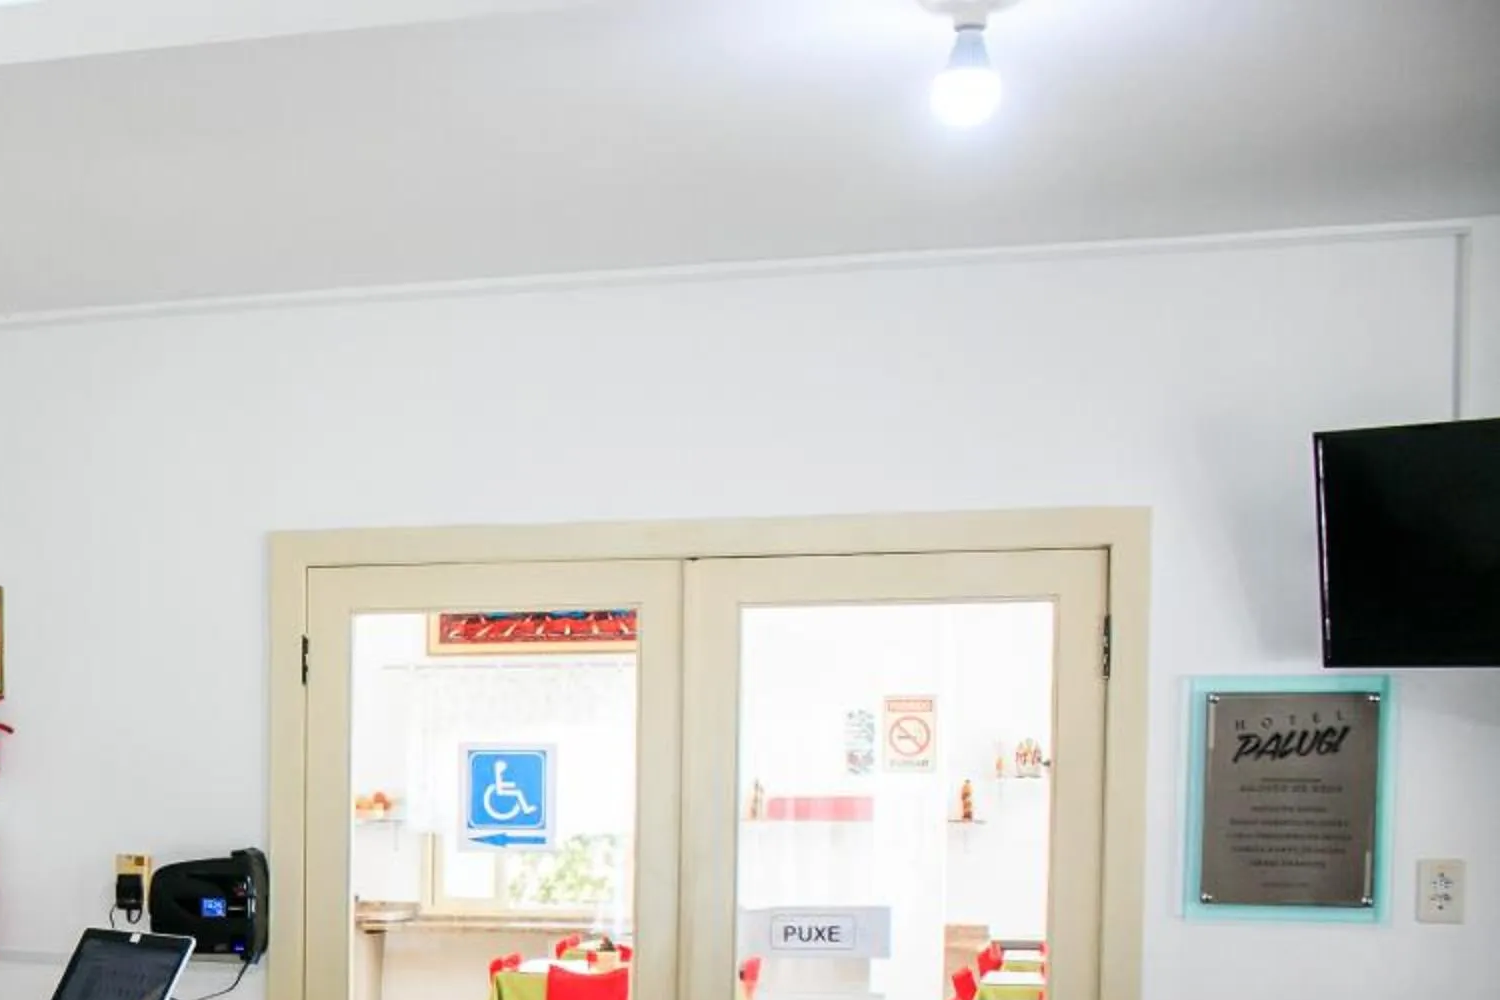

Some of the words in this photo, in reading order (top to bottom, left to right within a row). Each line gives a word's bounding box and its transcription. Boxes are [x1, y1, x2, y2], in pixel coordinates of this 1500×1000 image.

[1235, 708, 1344, 731] HOTEL
[1231, 725, 1352, 764] PALUGI
[782, 925, 841, 942] PUXE
